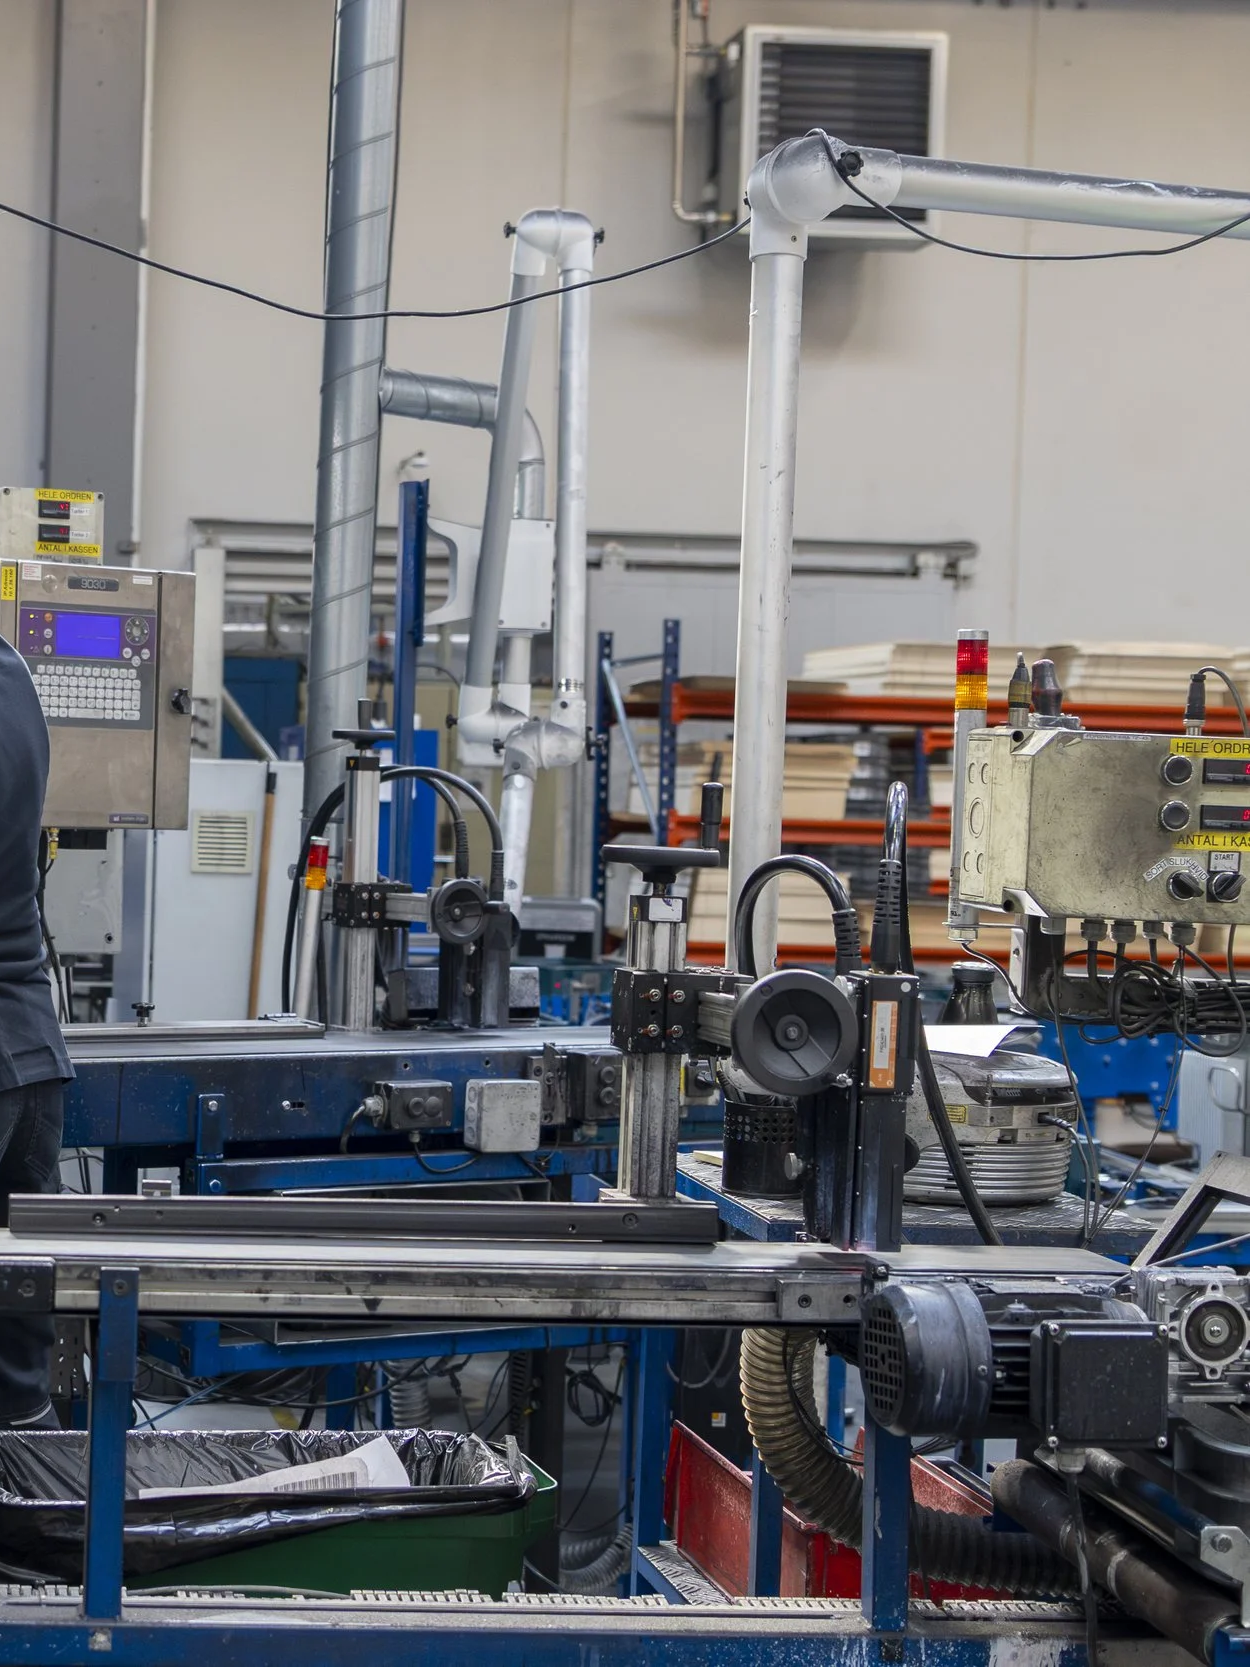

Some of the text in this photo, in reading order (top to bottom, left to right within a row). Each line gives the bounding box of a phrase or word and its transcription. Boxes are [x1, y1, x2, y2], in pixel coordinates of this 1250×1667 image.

[38, 490, 92, 500] HELE ORDREN
[38, 544, 61, 552] ANTAL
[69, 545, 98, 553] KASSEN
[81, 578, 106, 589] 9030
[1176, 742, 1250, 754] HELE ORDR
[1177, 834, 1218, 846] ANTAL
[1231, 836, 1250, 847] KA
[1169, 858, 1191, 866] SLUK
[1214, 853, 1235, 861] START
[1146, 859, 1168, 879] SORT
[1189, 861, 1208, 880] HVID
